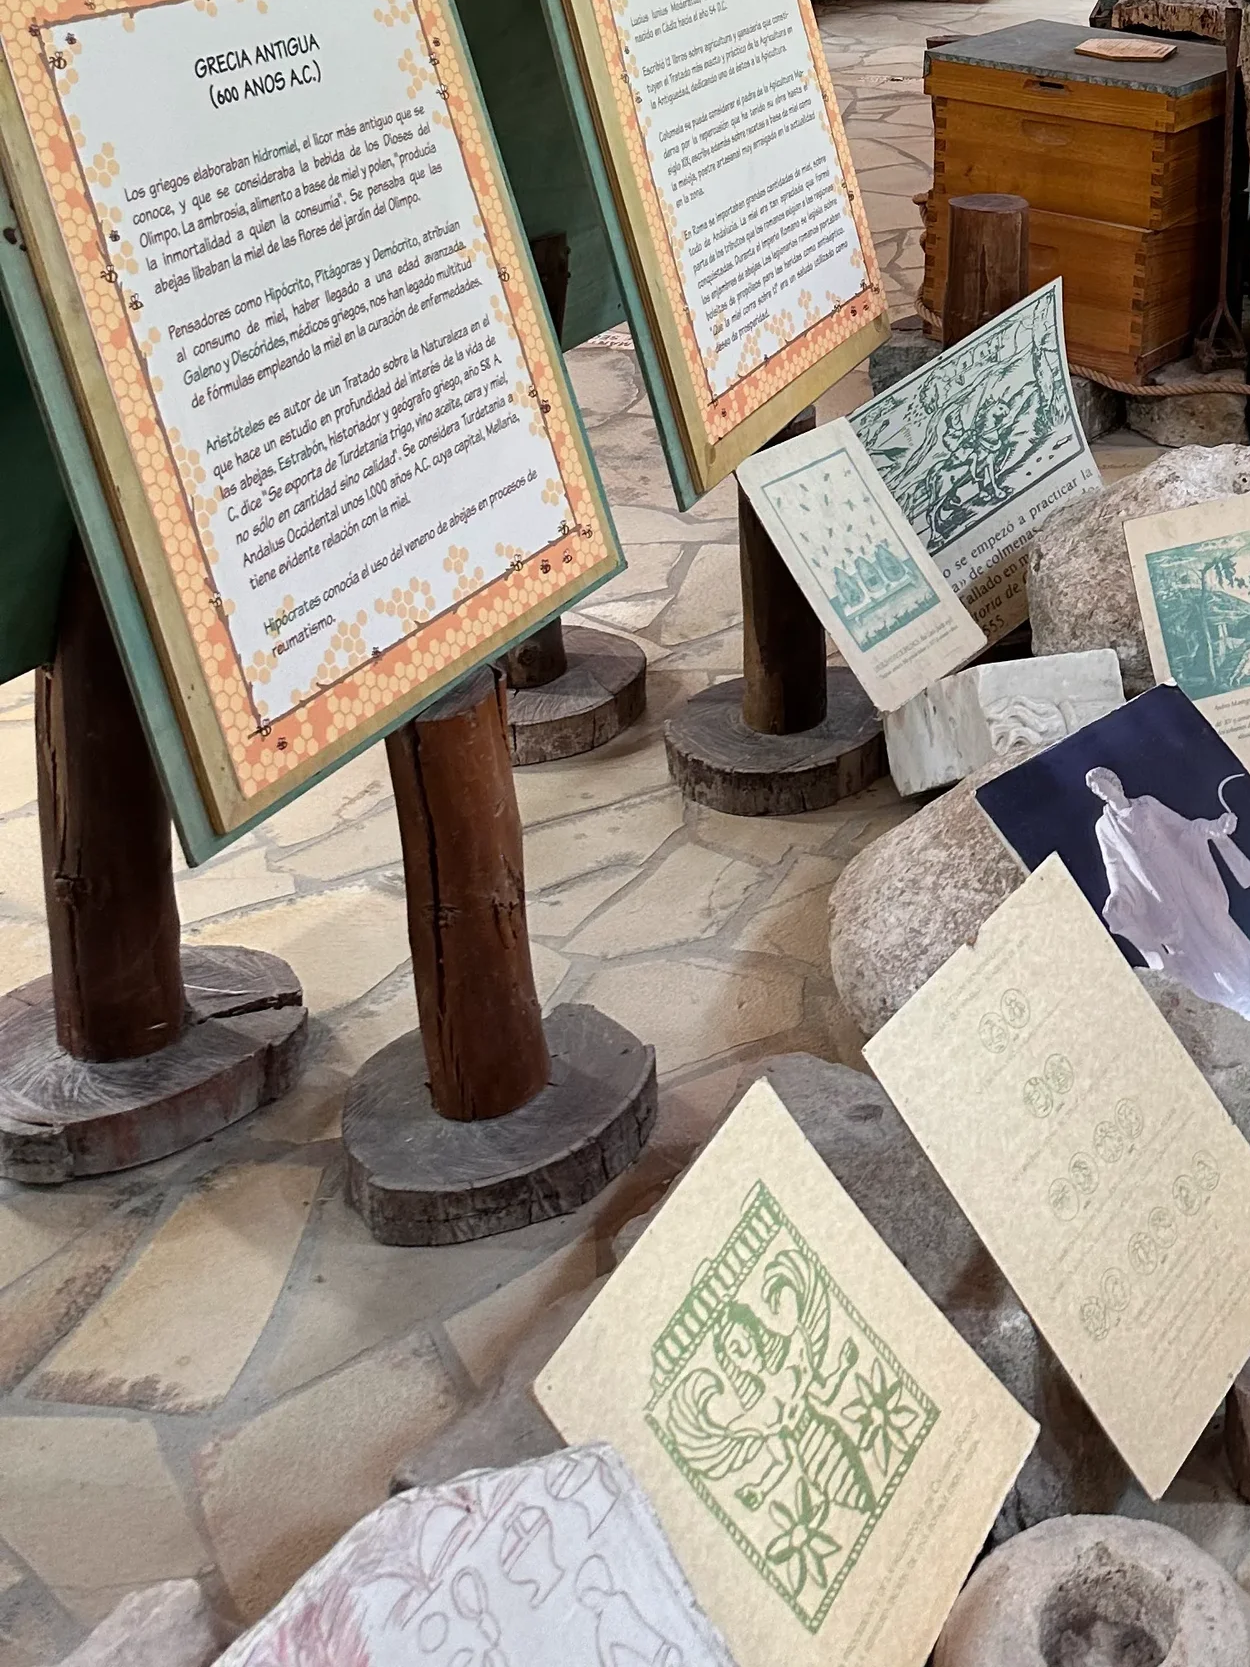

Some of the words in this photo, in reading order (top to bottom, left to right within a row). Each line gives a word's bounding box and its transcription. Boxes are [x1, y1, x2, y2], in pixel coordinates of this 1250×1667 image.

[193, 48, 253, 79] GRECIA
[254, 32, 320, 65] ANTIGUA
[208, 83, 240, 109] (600
[289, 58, 321, 88] A.C.)
[122, 186, 146, 203] Los
[148, 173, 190, 199] griegos
[192, 155, 251, 182] elaboraban
[250, 138, 301, 164] hidromiel,
[301, 134, 312, 150] el
[311, 130, 334, 146] licor
[335, 122, 357, 140] más
[358, 113, 394, 133] antiguo
[394, 108, 412, 126] que
[412, 105, 425, 117] se
[131, 203, 176, 226] conoce,
[177, 198, 186, 215] y
[190, 191, 212, 211] que
[215, 186, 230, 199] se
[233, 164, 296, 194] consideraba
[297, 158, 310, 173] la
[311, 148, 346, 169] bebida
[348, 143, 362, 158] de
[362, 139, 380, 153] los
[381, 129, 414, 147] Dioses
[416, 120, 431, 137] del
[138, 226, 181, 248] Olimpo.
[179, 219, 196, 235] La
[196, 201, 250, 230] ambrosía,
[249, 189, 293, 213] alimento
[293, 186, 302, 198] a
[300, 178, 327, 196] base
[326, 171, 340, 187] de
[339, 164, 360, 182] miel
[359, 165, 367, 180] y
[367, 156, 395, 178] polen,
[144, 256, 158, 271] la
[160, 229, 232, 266] inmortalidad
[235, 228, 244, 241] a
[248, 218, 277, 240] quien
[278, 211, 291, 226] la
[348, 186, 364, 202] Se
[365, 174, 406, 201] pensaba
[408, 168, 426, 186] que
[426, 162, 443, 175] las
[954, 556, 968, 572] se
[970, 523, 1015, 558] empezó
[1018, 516, 1027, 524] a
[1029, 477, 1078, 520] practicar
[1081, 467, 1093, 484] la
[969, 566, 984, 582] de
[1003, 561, 1018, 577] en
[1005, 586, 1022, 600] de
